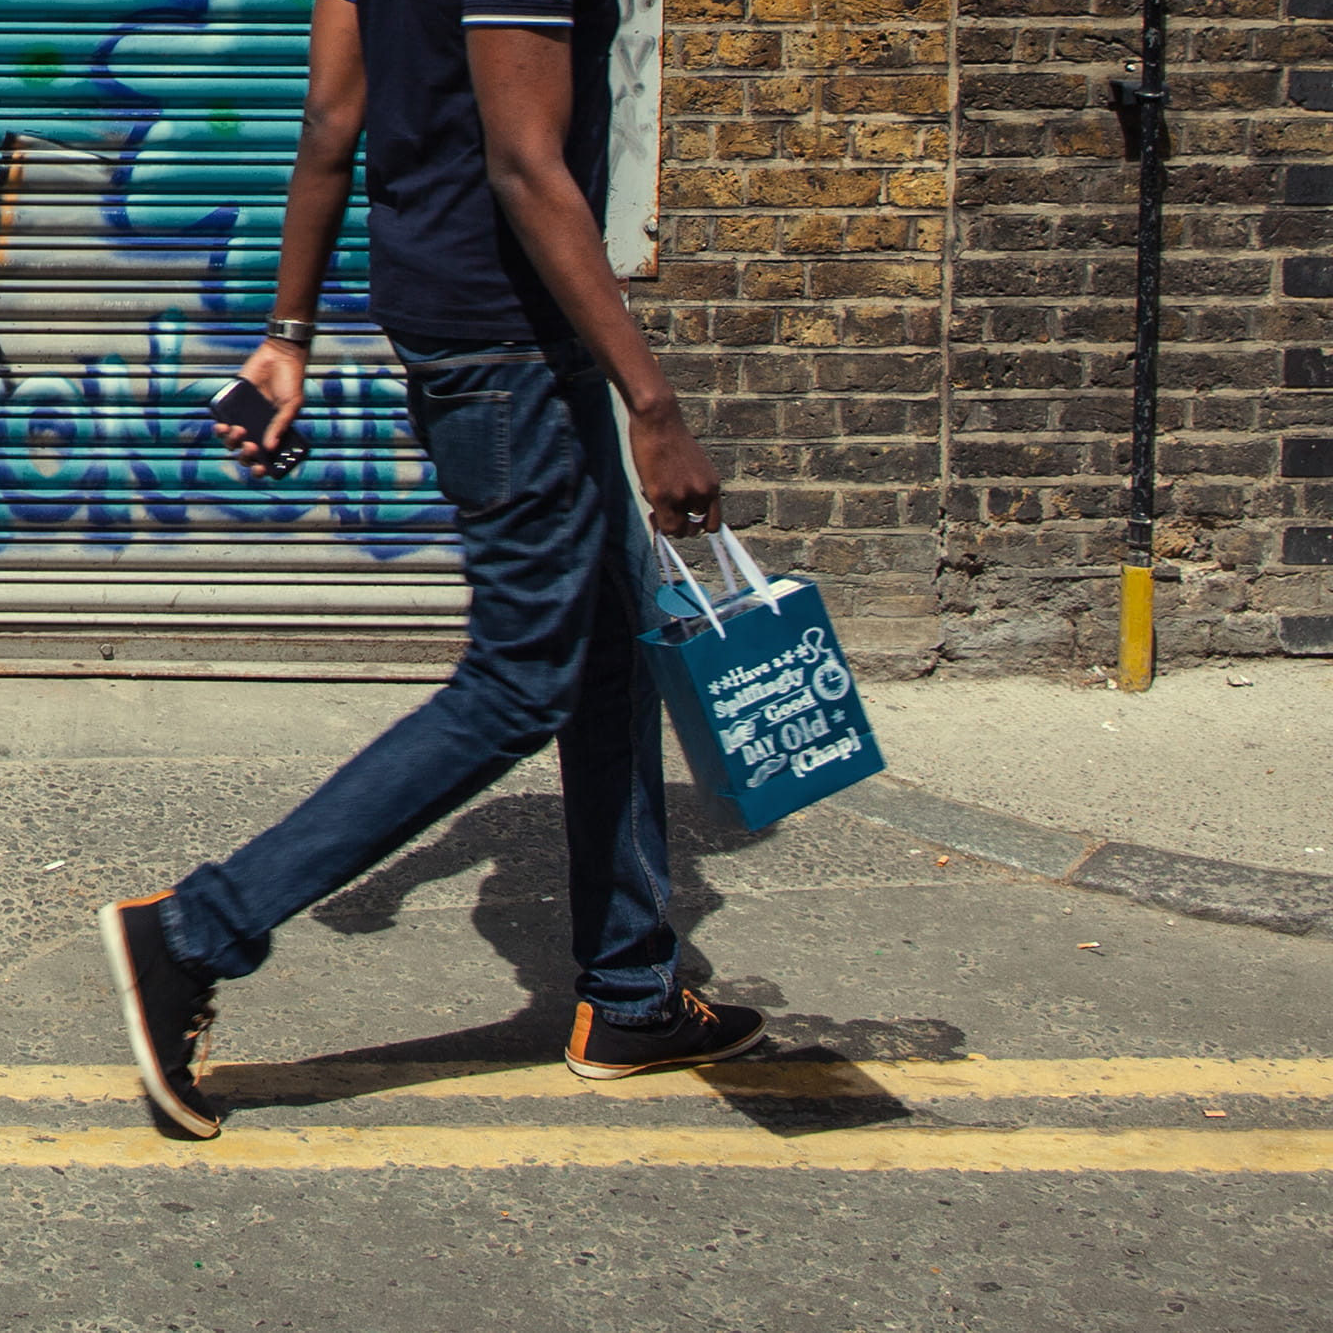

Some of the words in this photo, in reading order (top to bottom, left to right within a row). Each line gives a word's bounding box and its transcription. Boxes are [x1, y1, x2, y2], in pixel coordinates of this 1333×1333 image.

[728, 663, 771, 687] Have
[764, 688, 817, 721] Good
[741, 734, 777, 765] DAY
[780, 709, 832, 750] Old
